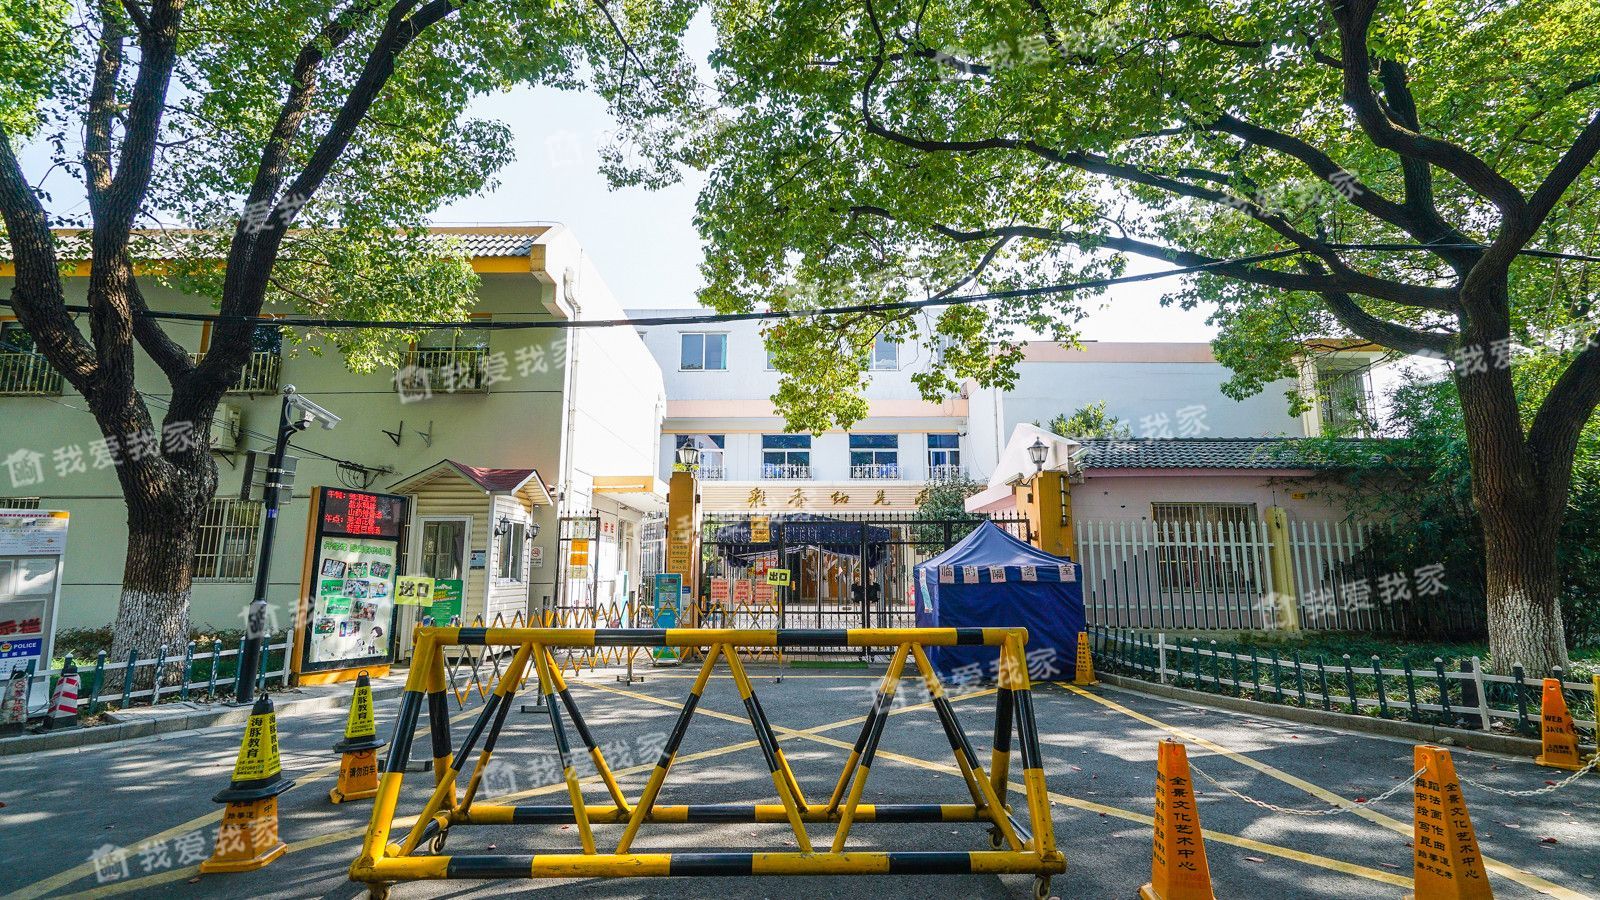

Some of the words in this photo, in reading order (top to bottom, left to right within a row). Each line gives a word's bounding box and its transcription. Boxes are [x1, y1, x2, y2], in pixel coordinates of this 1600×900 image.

[768, 571, 788, 582] 出口
[357, 688, 368, 720] 海豚教育
[1544, 714, 1563, 724] WEB
[246, 717, 264, 759] 海豚教育
[1415, 792, 1442, 806] 书法
[1416, 805, 1442, 821] 绘画
[1168, 776, 1198, 871] 全景文化艺术中心
[1417, 821, 1445, 836] 写作
[1444, 782, 1480, 879] 全景文化艺术中心
[1419, 836, 1446, 852] 昆曲
